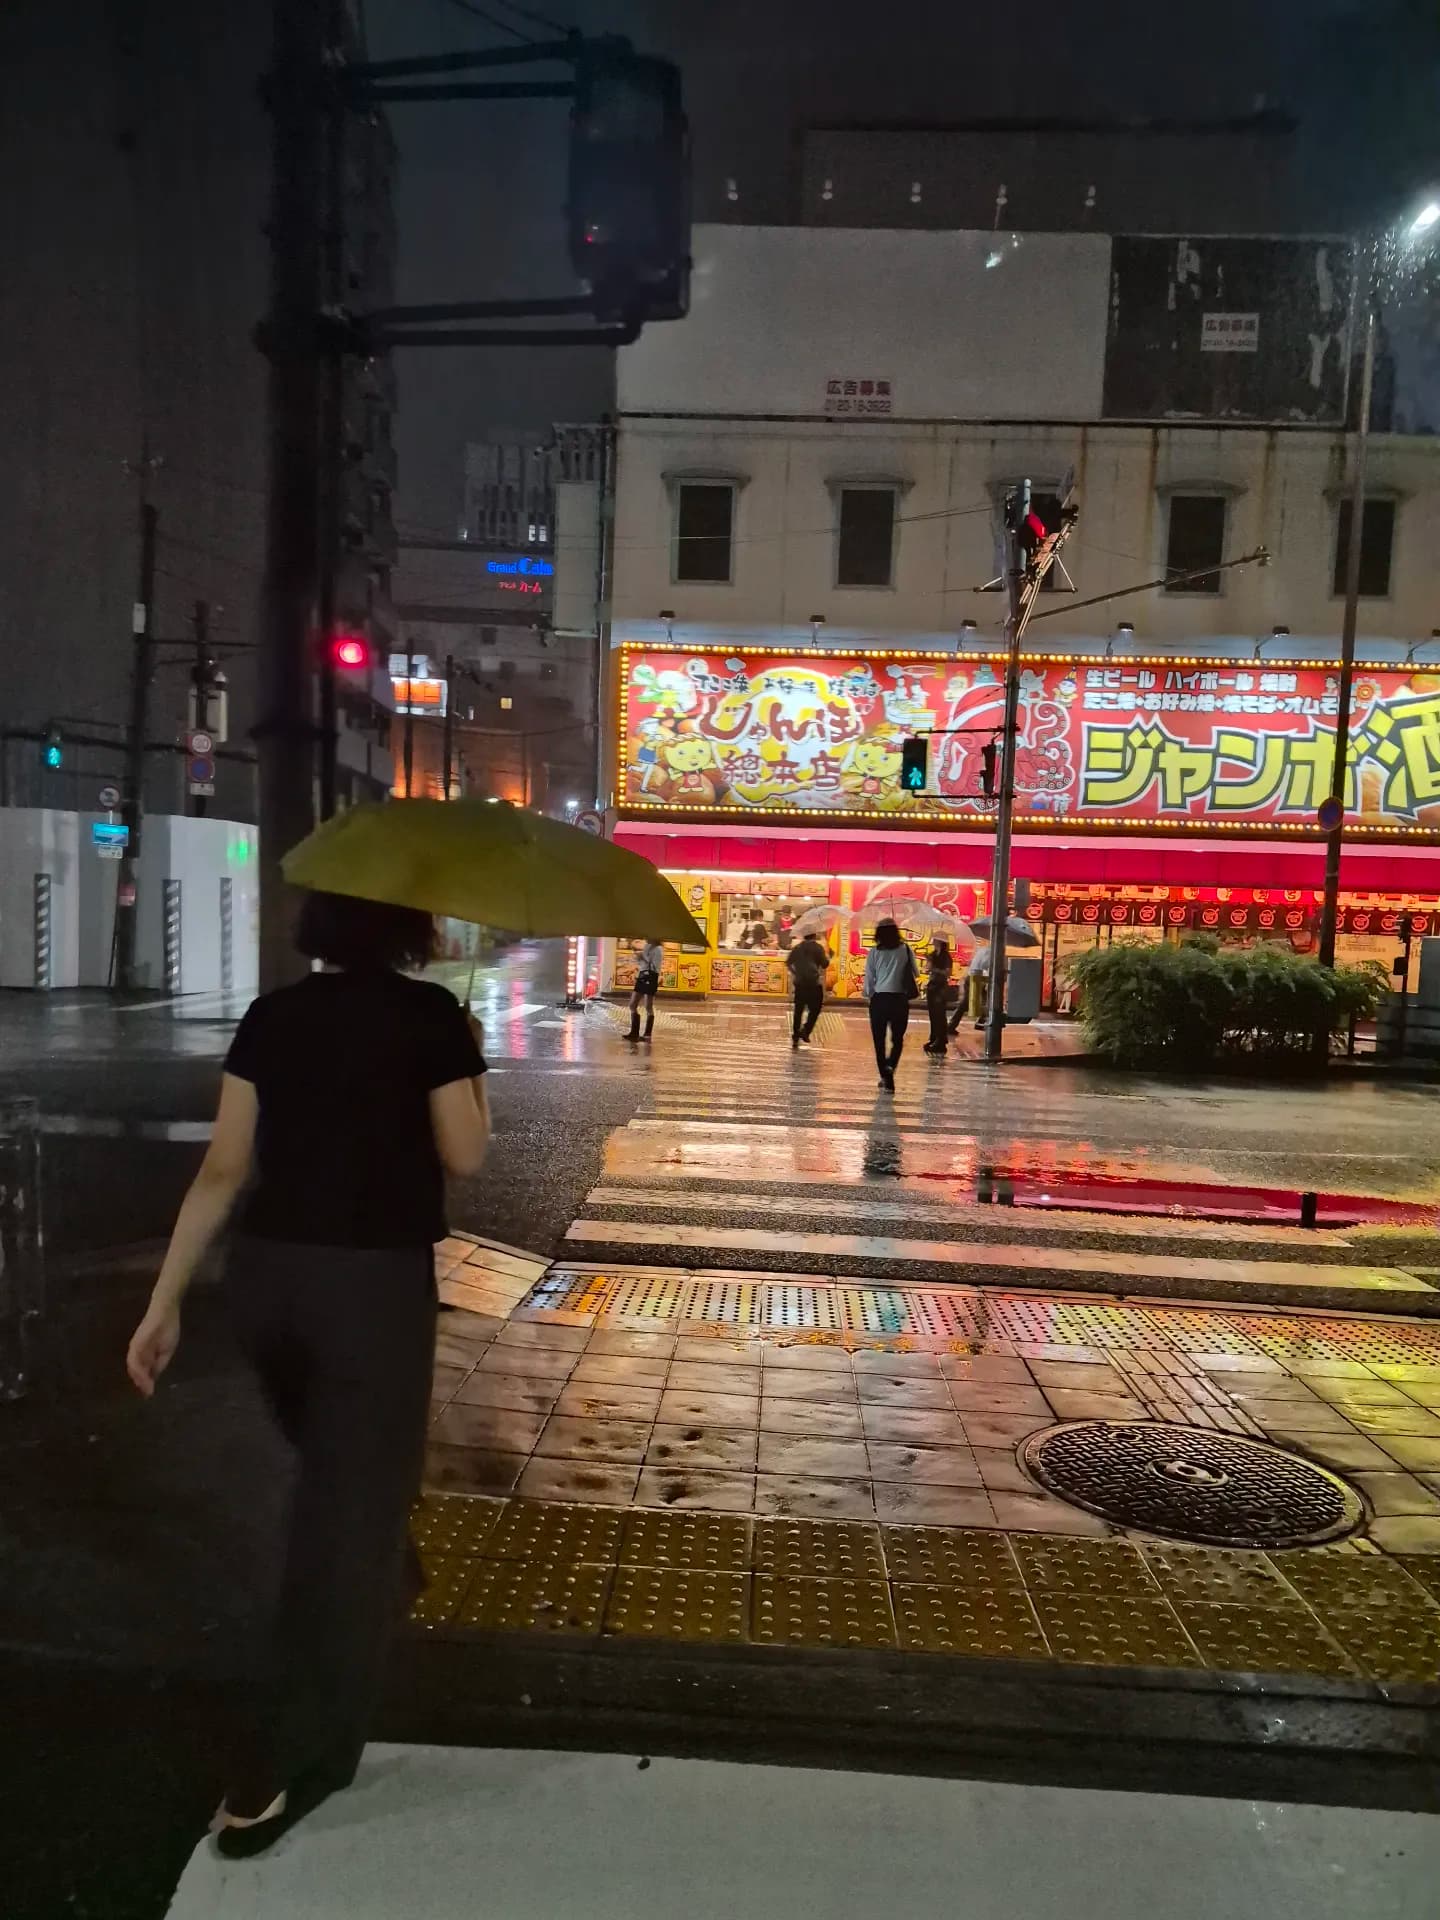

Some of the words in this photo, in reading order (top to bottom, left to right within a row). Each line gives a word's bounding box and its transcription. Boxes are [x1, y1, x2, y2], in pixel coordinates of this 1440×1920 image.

[826, 380, 891, 395] 広告募集
[1086, 669, 1156, 689] 生ビール
[1164, 671, 1253, 691] ハイボール
[698, 697, 872, 743] じゃんぼ
